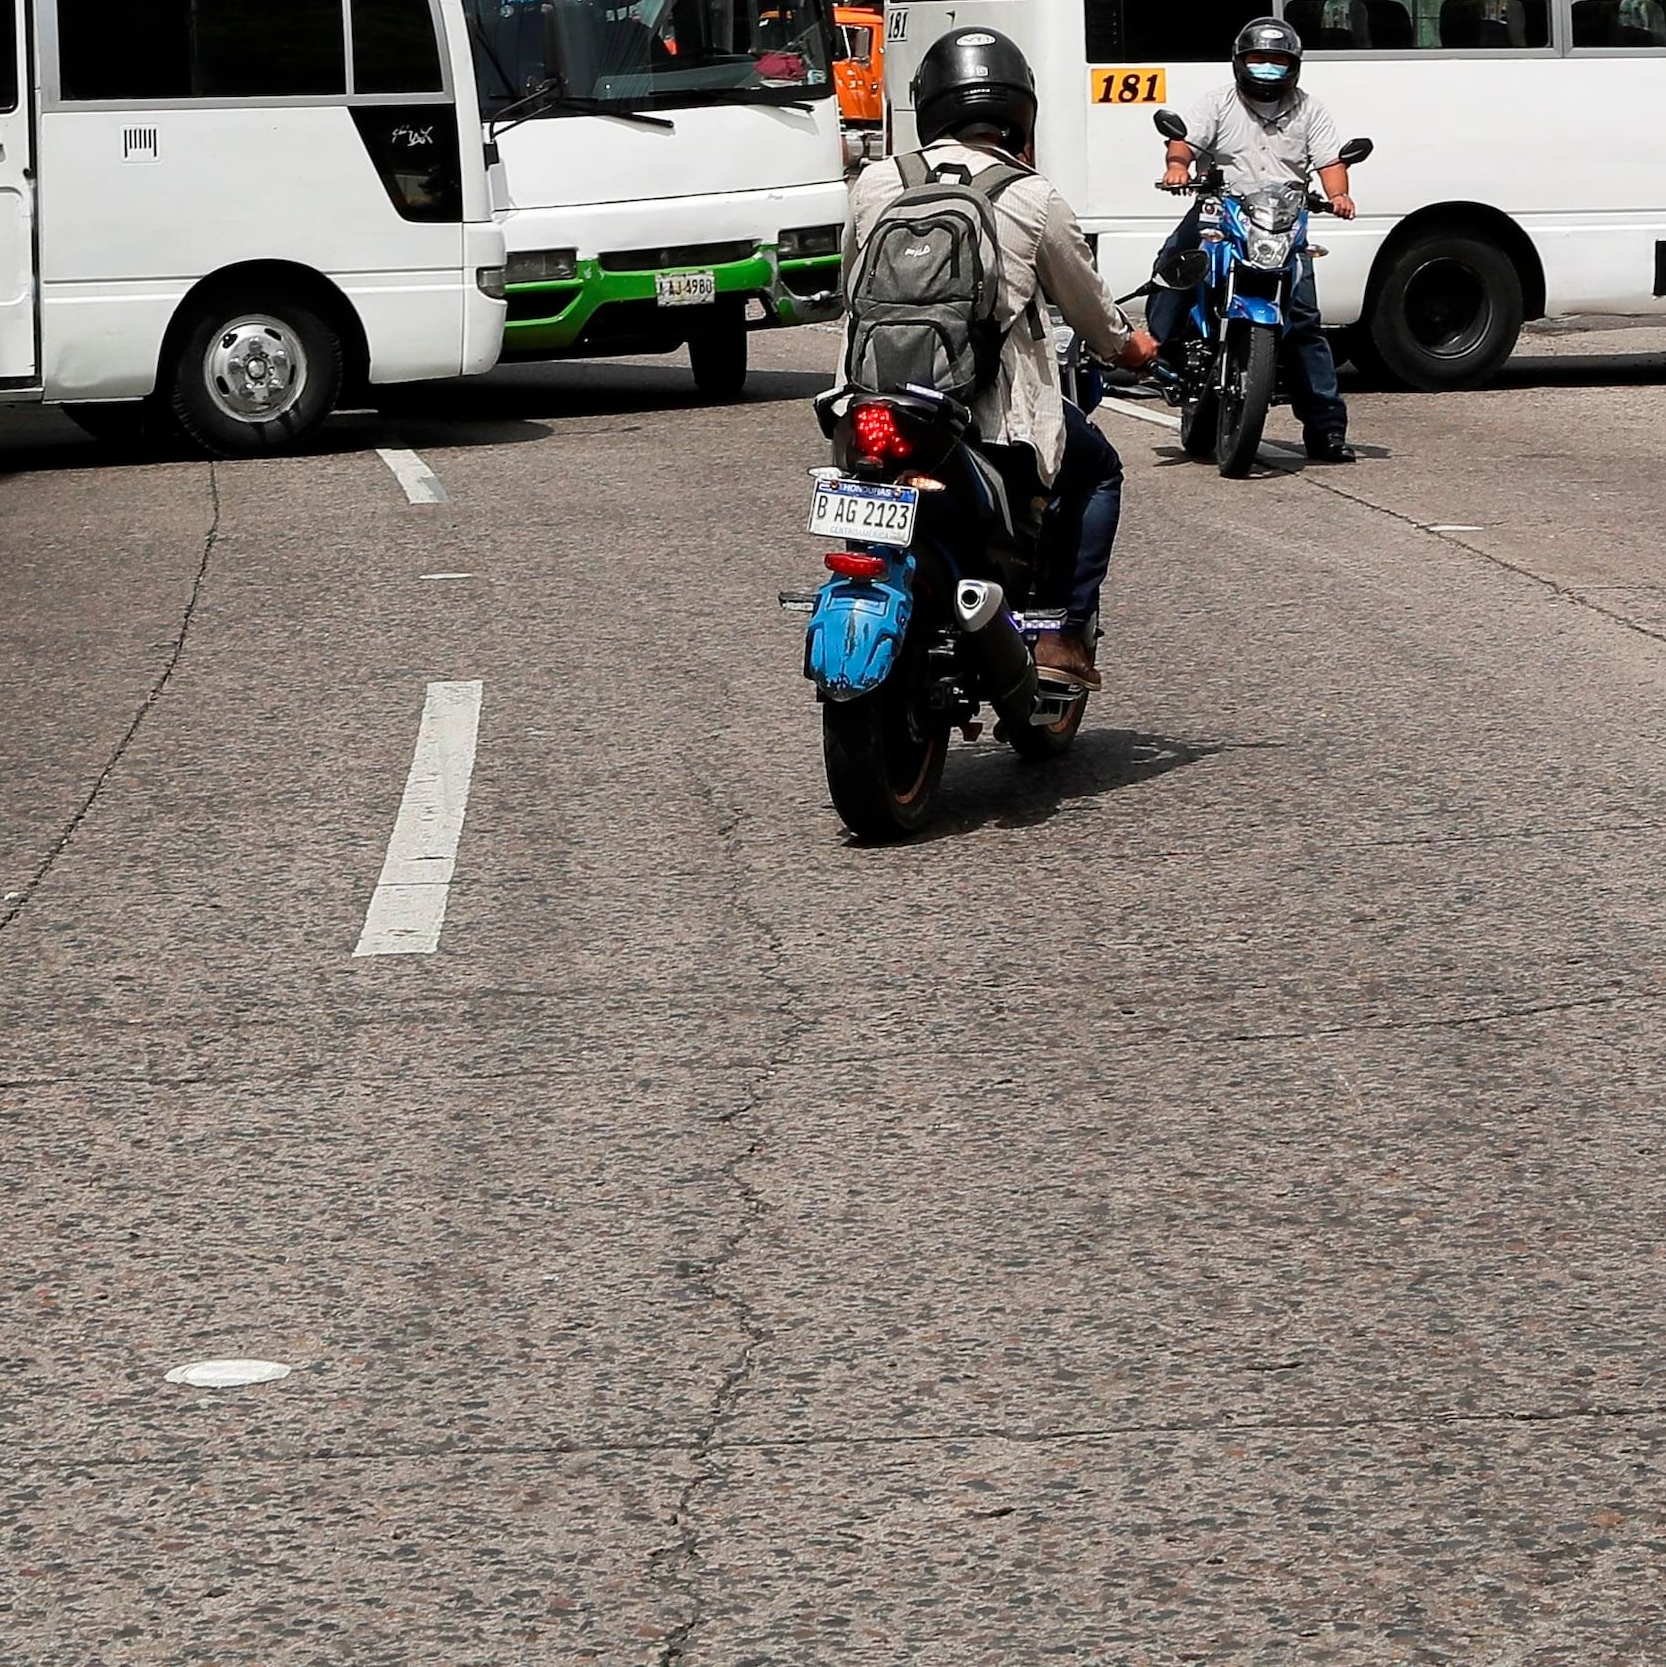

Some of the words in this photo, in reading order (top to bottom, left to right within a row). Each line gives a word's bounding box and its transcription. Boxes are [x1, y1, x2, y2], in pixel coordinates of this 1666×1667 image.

[888, 11, 908, 39] 181
[1098, 73, 1159, 103] 181
[684, 278, 712, 295] 4980
[843, 483, 893, 496] HONDURAS
[817, 495, 829, 519] B
[834, 497, 859, 523] AG
[863, 501, 910, 530] 2123
